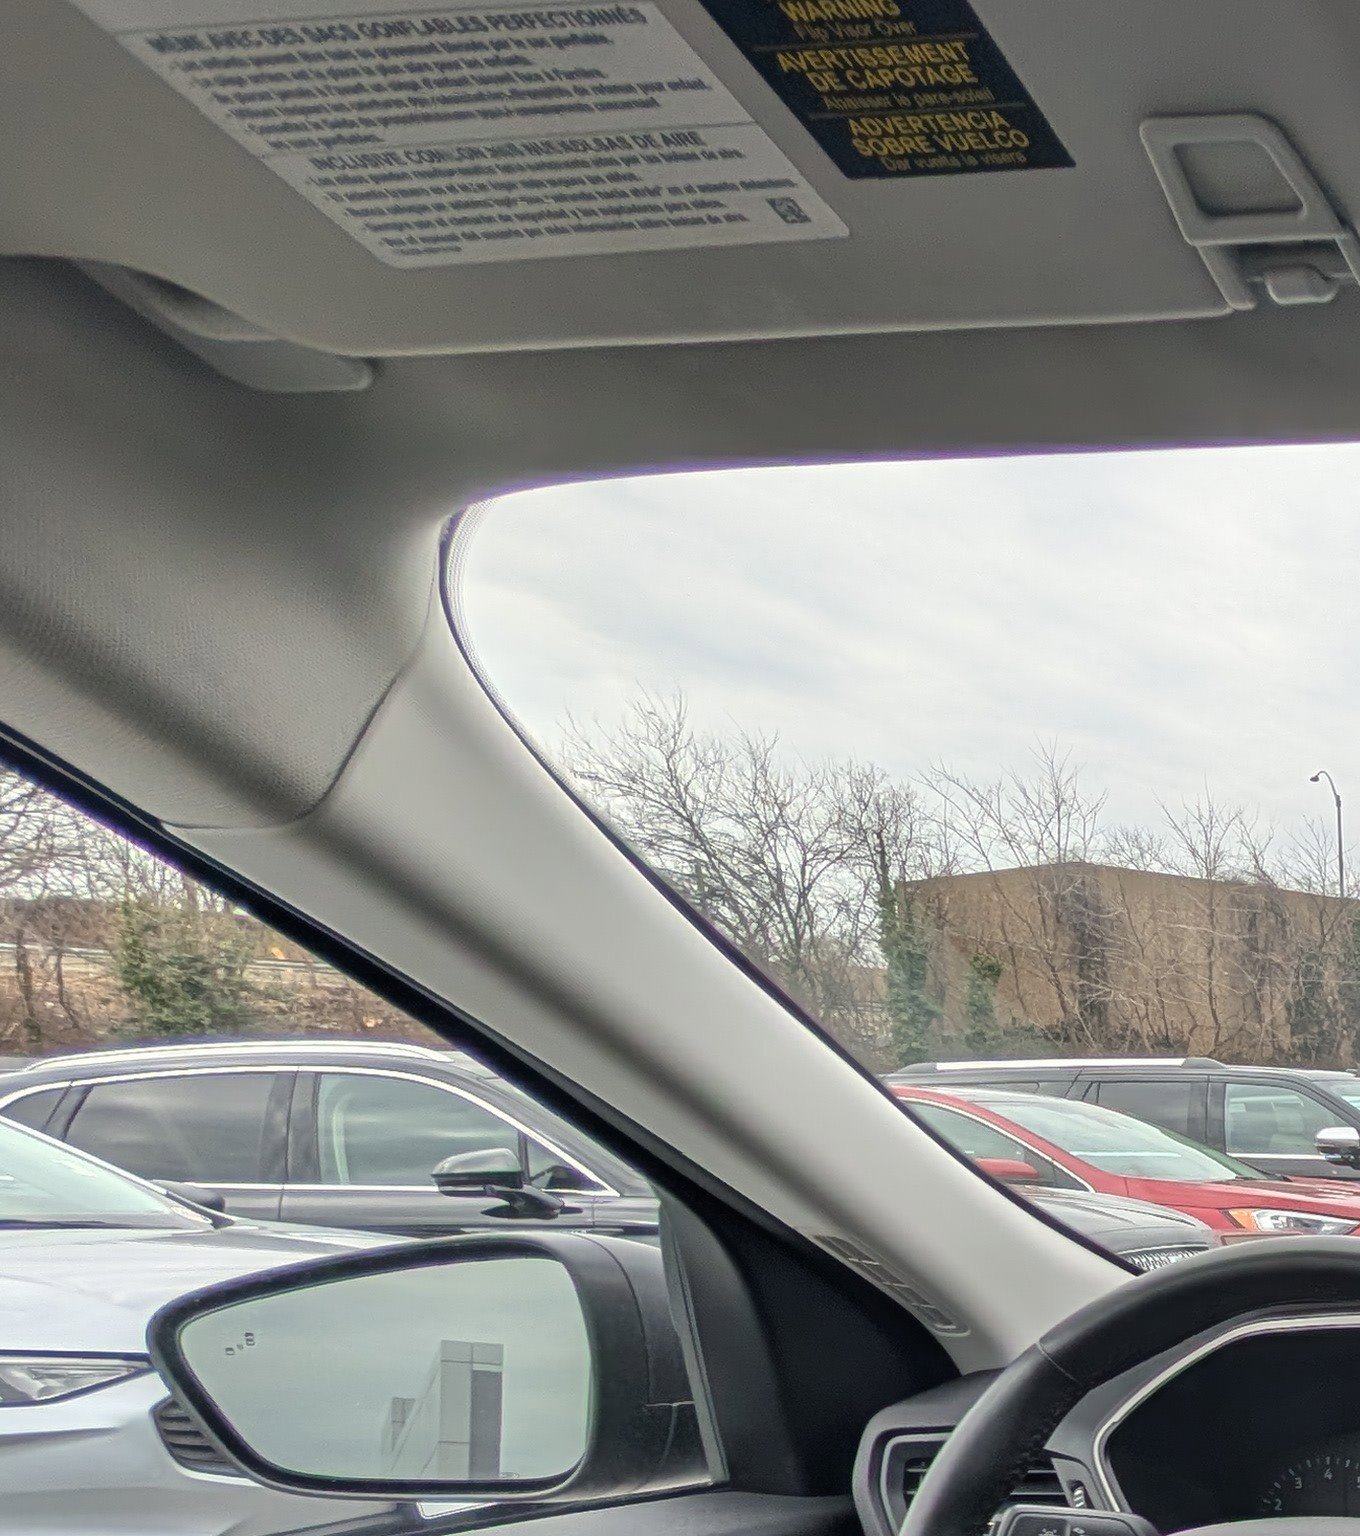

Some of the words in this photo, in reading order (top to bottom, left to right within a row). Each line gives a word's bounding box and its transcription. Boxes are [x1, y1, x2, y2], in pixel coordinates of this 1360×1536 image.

[782, 0, 898, 20] WARNING
[775, 42, 968, 69] AVERTISSEMENT
[809, 70, 843, 92] DE
[847, 64, 976, 88] CAPOTAGE
[847, 111, 1008, 134] ADVERTENCIA
[853, 135, 933, 156] SOBRE
[934, 130, 1028, 150] VUELCO
[1295, 1477, 1302, 1489] 3
[1324, 1468, 1333, 1480] 4
[1274, 1498, 1282, 1511] 2
